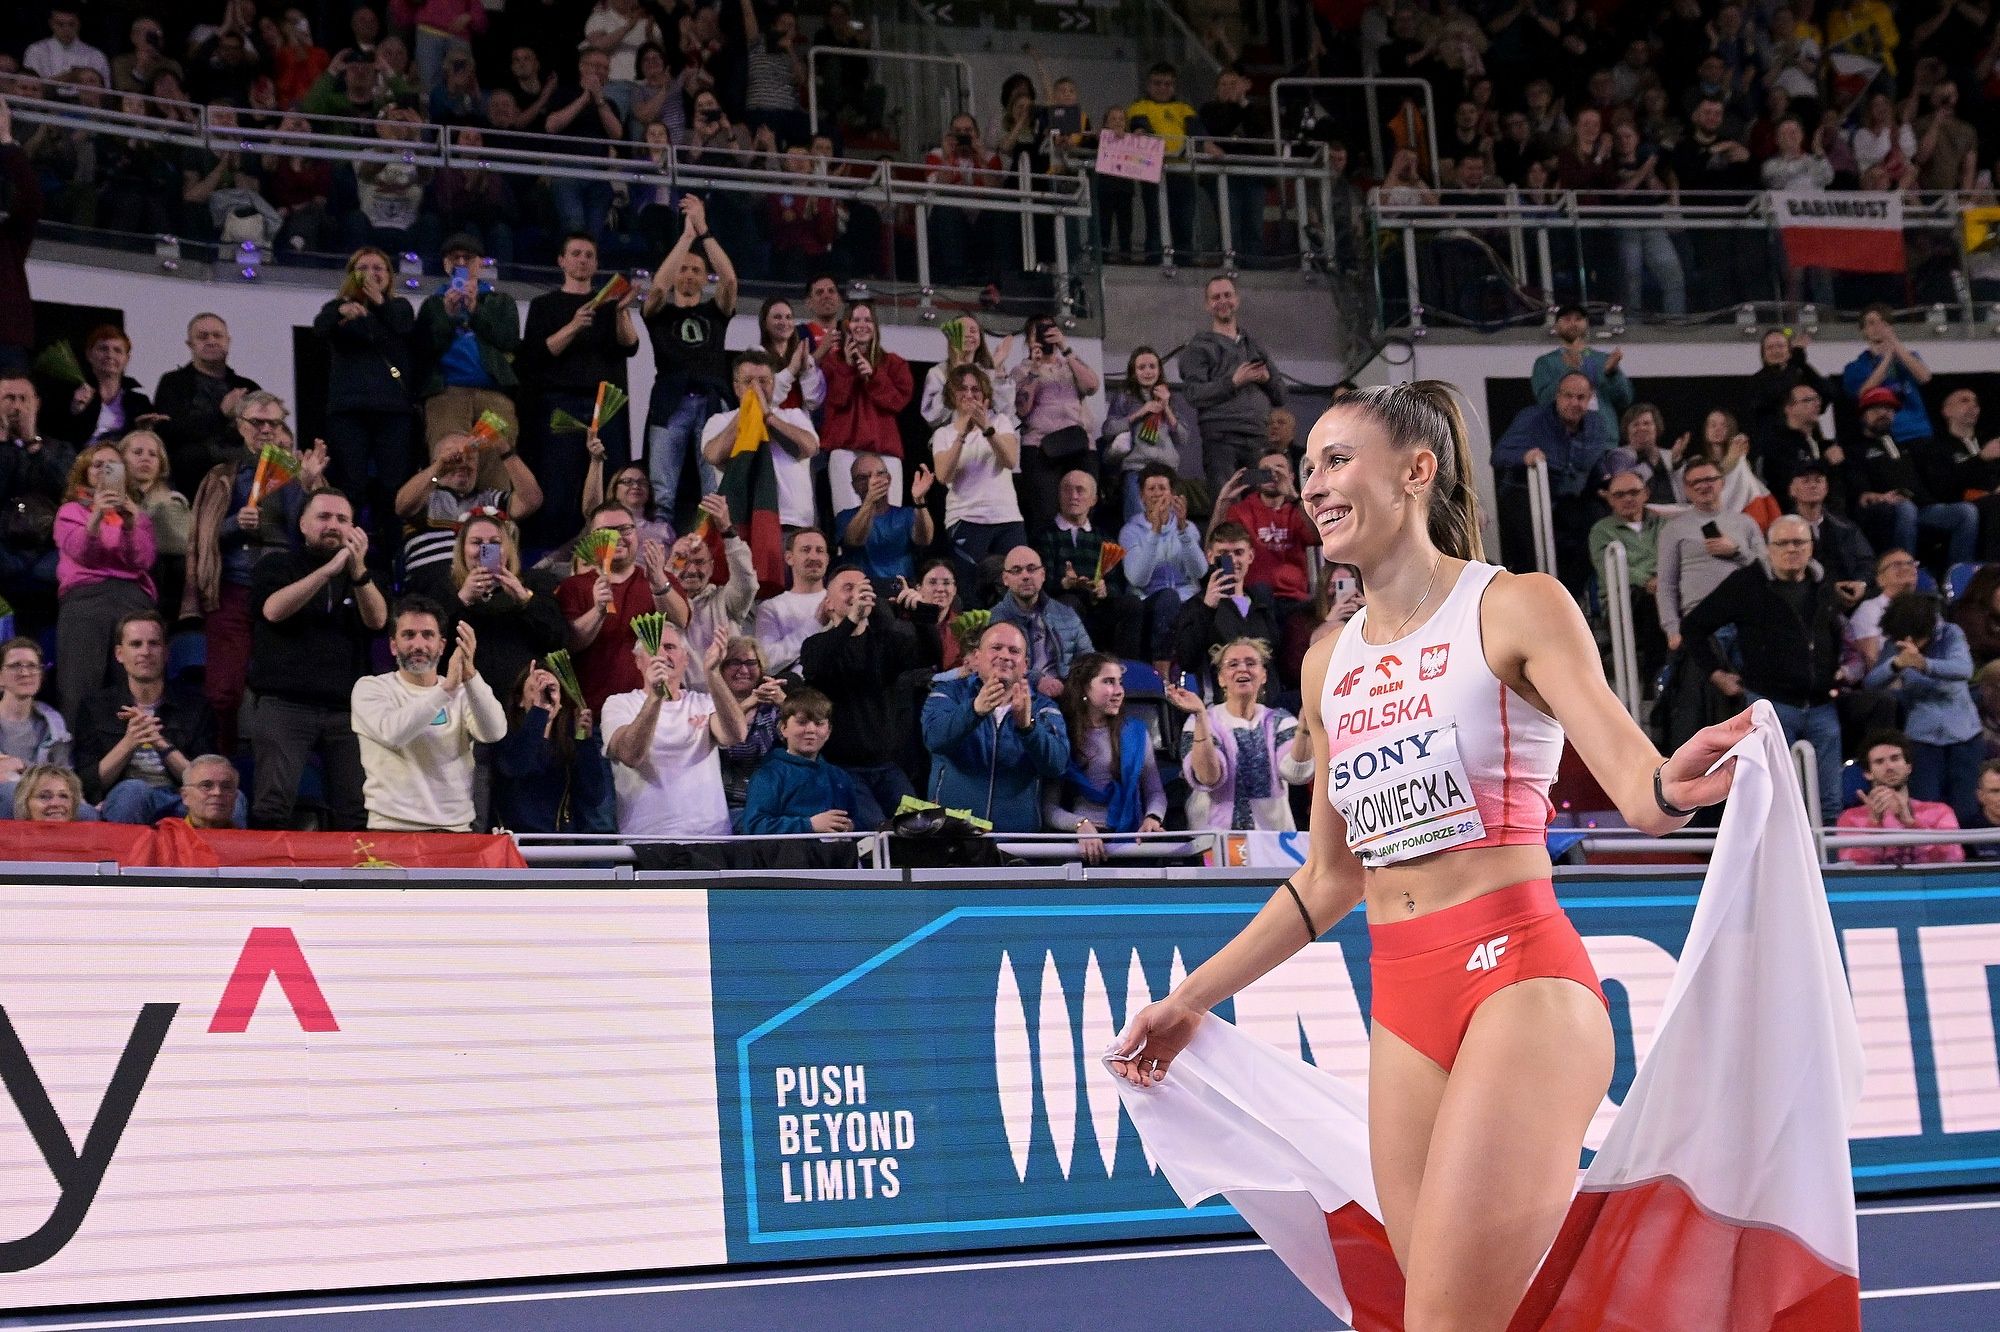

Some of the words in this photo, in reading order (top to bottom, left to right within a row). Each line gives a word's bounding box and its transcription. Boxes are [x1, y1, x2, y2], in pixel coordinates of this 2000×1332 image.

[1333, 665, 1365, 698] 4F
[1369, 680, 1404, 697] ORLEN
[1337, 693, 1433, 740] POLSKA
[1334, 729, 1439, 792] SONY
[1402, 825, 1457, 850] POMORZE
[1465, 934, 1509, 972] 4F
[775, 1065, 867, 1107] PUSH
[778, 1110, 916, 1155] BEYOND
[781, 1157, 901, 1203] LIMITS
